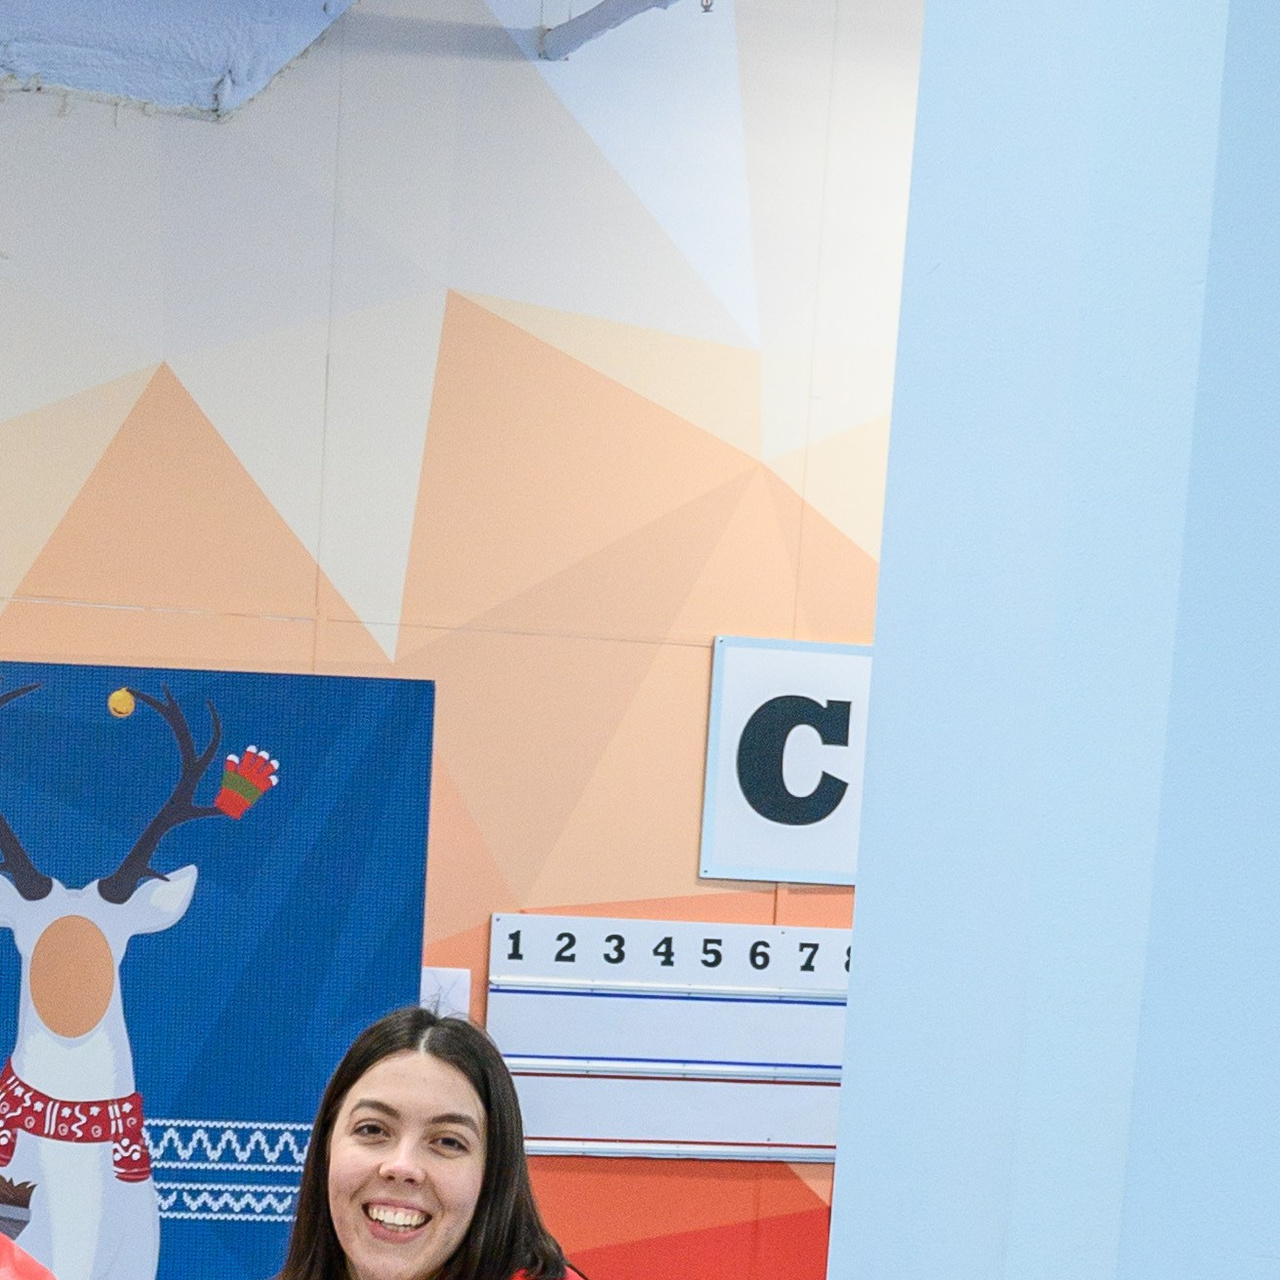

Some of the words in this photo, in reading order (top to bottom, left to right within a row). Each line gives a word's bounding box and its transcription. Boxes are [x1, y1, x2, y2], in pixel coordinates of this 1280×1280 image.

[736, 695, 852, 826] C
[507, 930, 524, 961] 1
[554, 932, 576, 963] 2
[603, 934, 626, 965] 3
[652, 936, 675, 967] 4
[701, 938, 722, 968] 5
[749, 940, 770, 970] 6
[799, 942, 819, 972] 7
